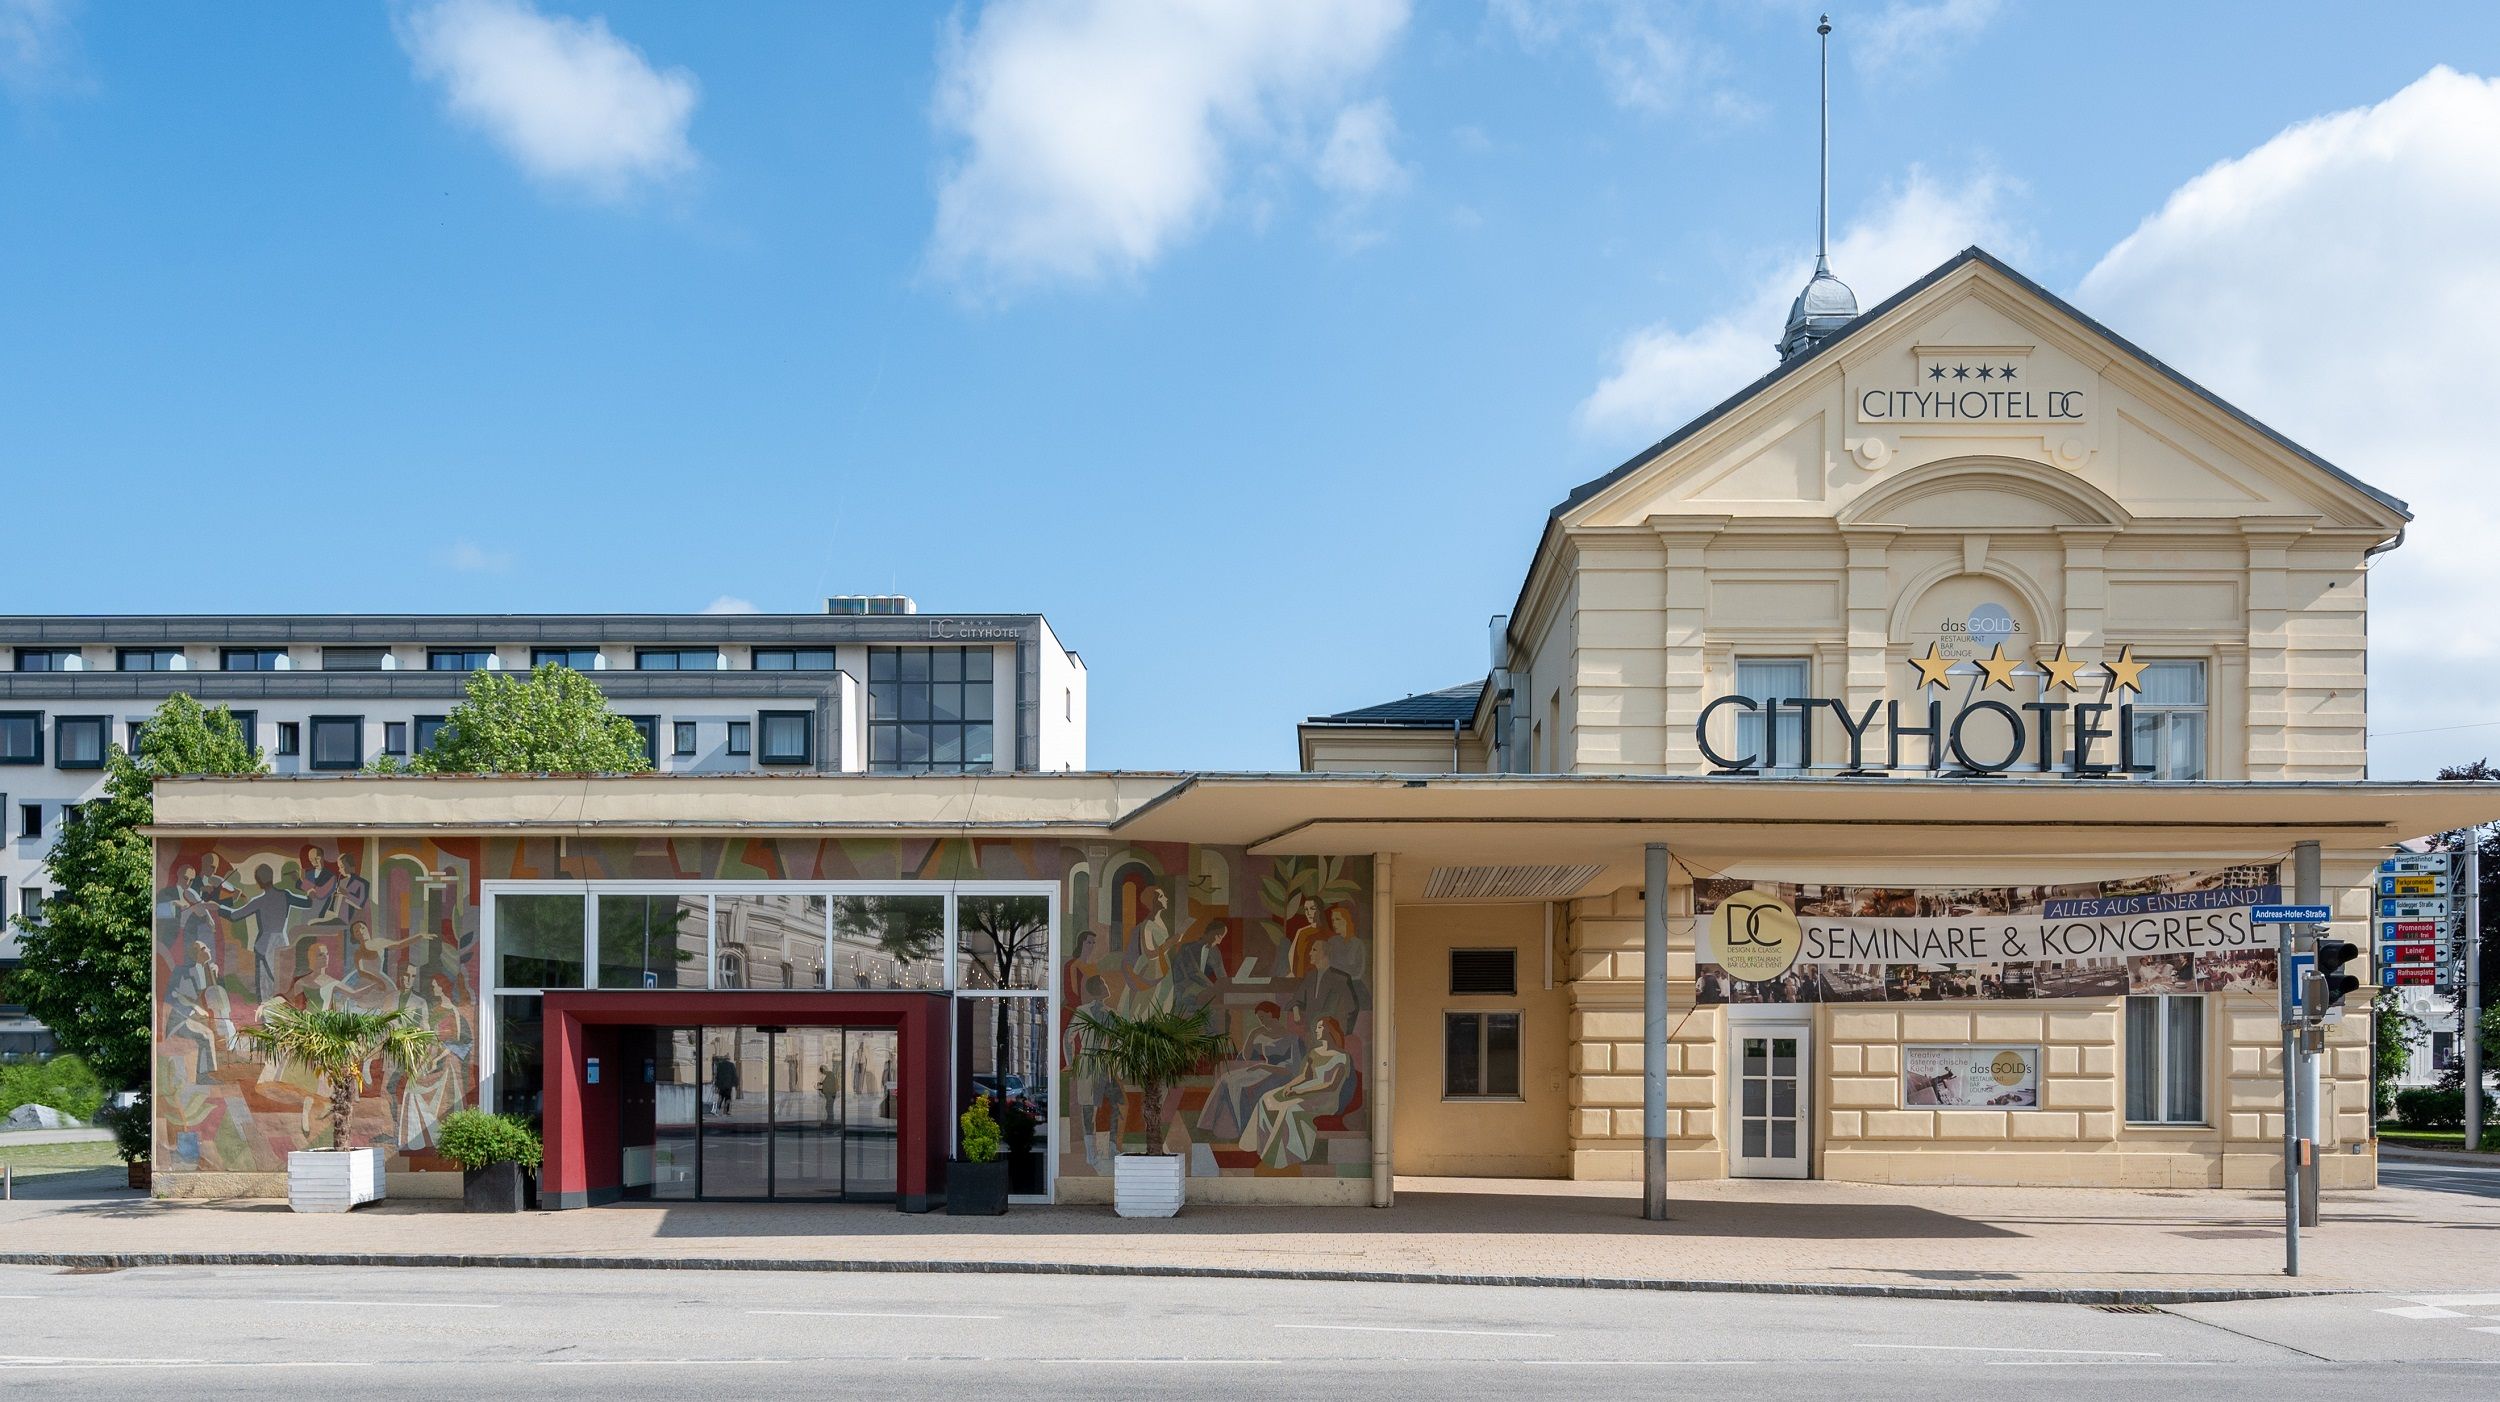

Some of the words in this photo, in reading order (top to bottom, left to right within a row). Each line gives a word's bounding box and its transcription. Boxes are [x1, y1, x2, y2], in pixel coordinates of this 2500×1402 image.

[1862, 390, 2039, 419] CITYHOTEL
[2048, 390, 2084, 419] DC
[929, 618, 954, 639] DC
[960, 628, 1020, 638] CITYHOTEL
[1940, 635, 1985, 643] RESTAURANT
[1695, 694, 2157, 773] CITYHOTEL
[2050, 900, 2099, 917] ALLES
[2104, 898, 2139, 914] AUS
[2147, 893, 2198, 911] EINER
[2204, 889, 2264, 908] HAND!
[2255, 909, 2327, 919] Andreas-Hofer-Straße
[1726, 903, 1782, 947] DC
[1806, 926, 1987, 959] SEMINARE
[2002, 929, 2028, 956] &
[2041, 911, 2267, 957] KONGRESSE
[2397, 969, 2434, 977] Rathausplatz
[1910, 1051, 1940, 1059] kreative
